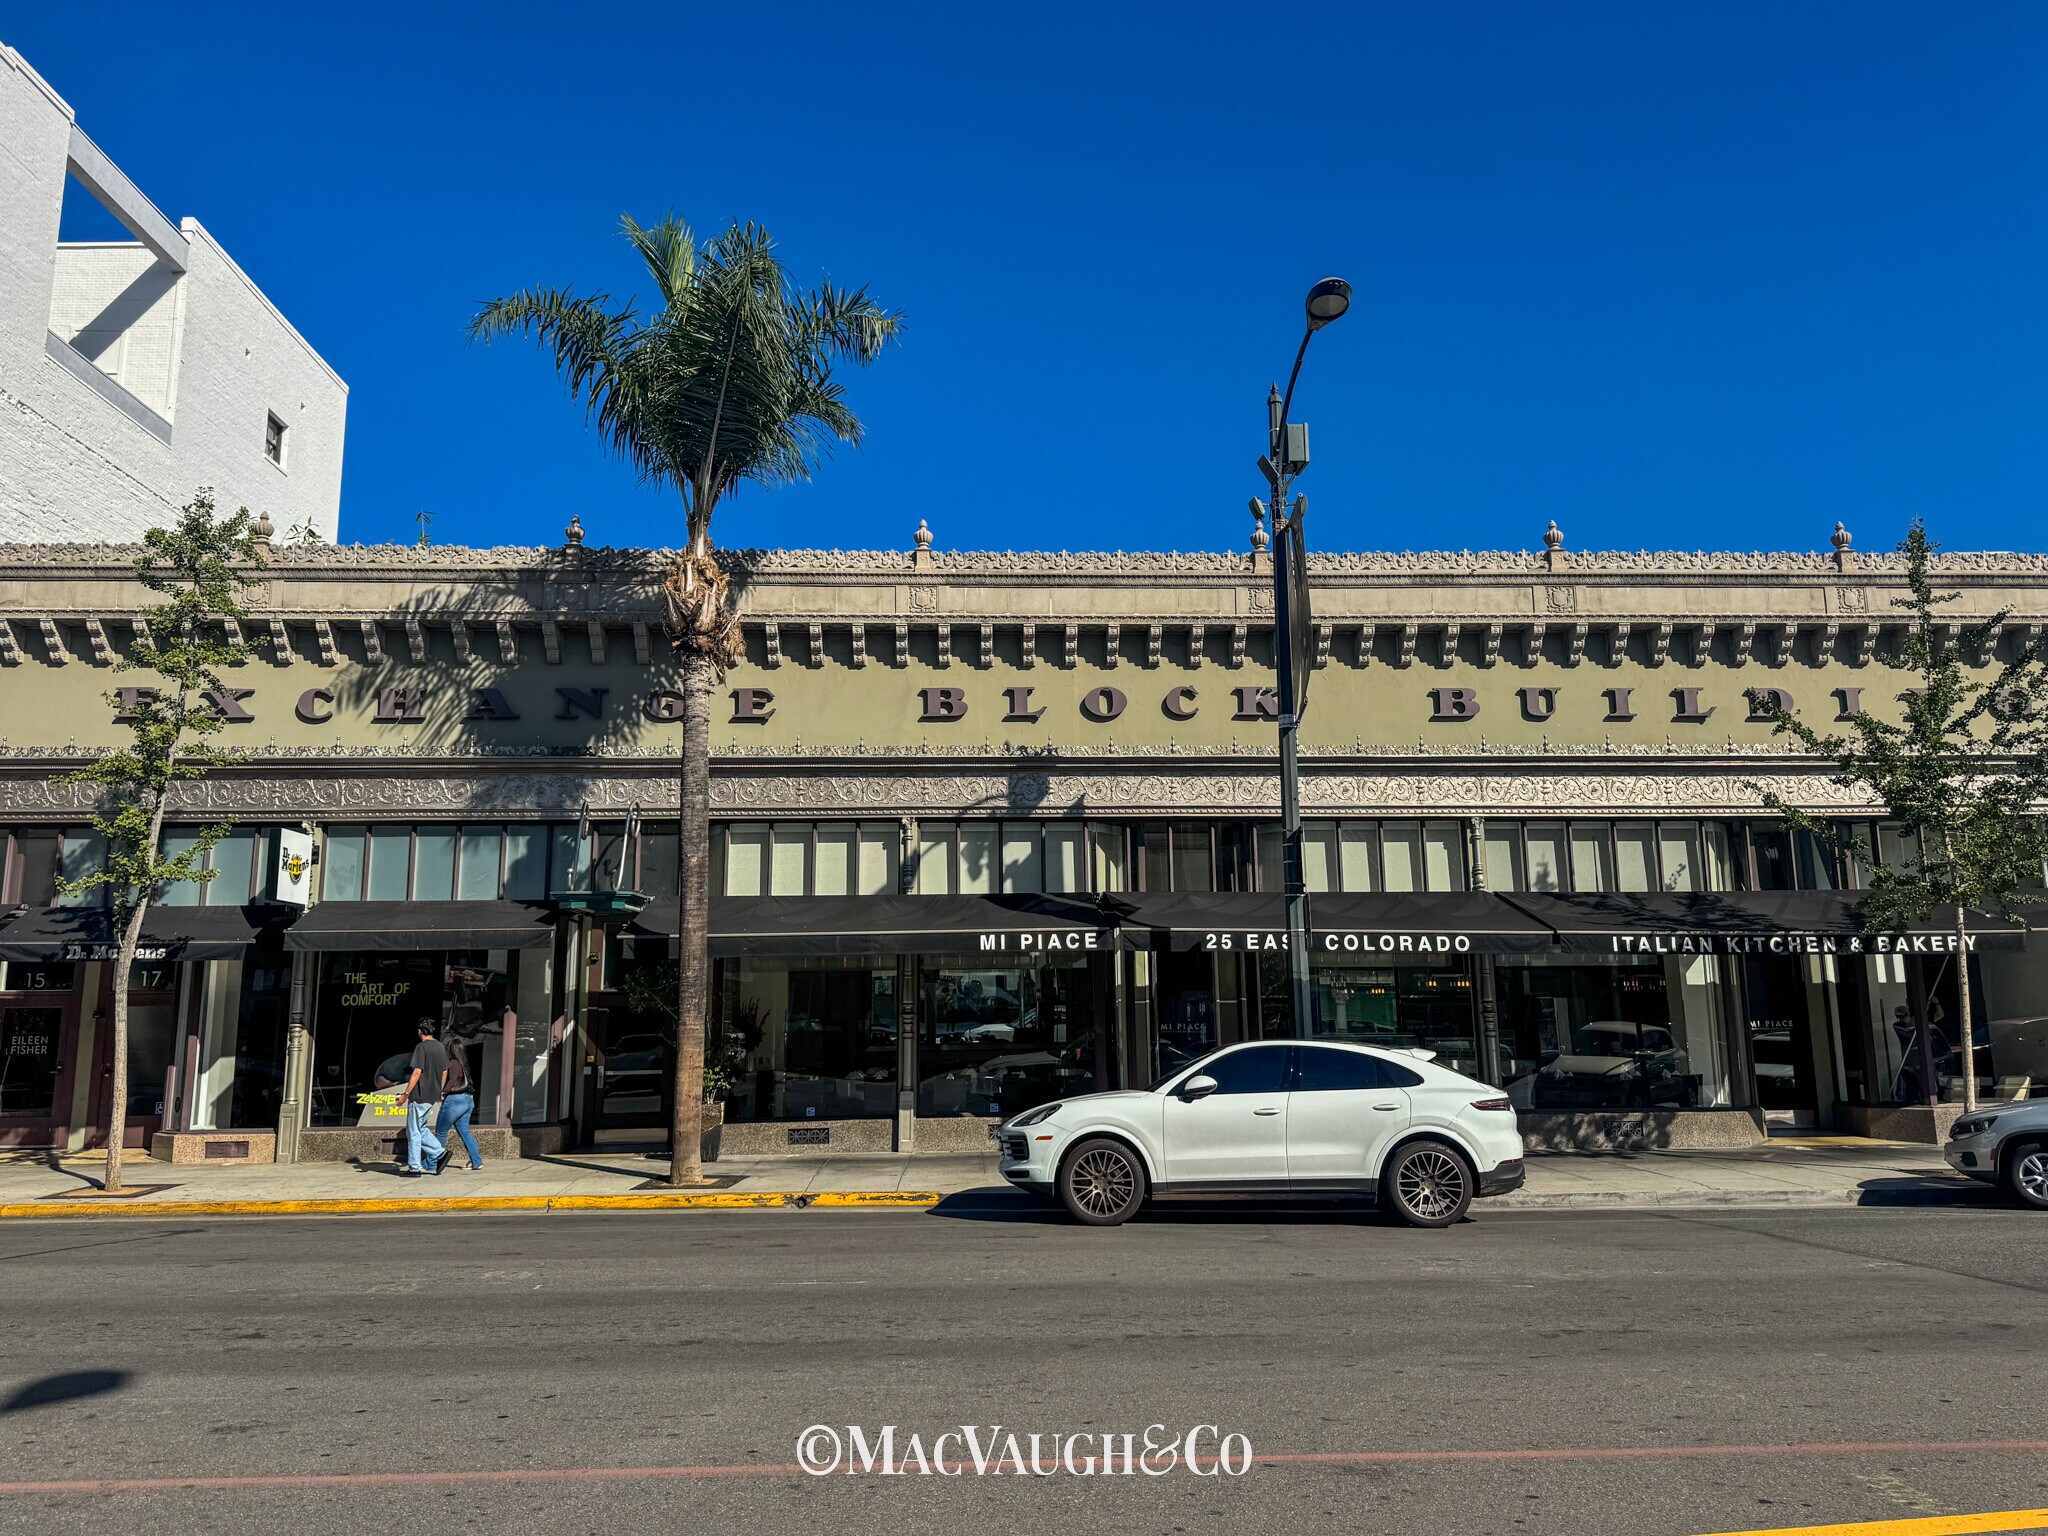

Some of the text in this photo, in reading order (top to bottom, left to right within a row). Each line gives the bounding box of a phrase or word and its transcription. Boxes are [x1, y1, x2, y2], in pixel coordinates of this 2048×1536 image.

[112, 685, 2041, 725] EXCHANGE BLOCK BUILDIG
[979, 932, 1098, 950] MI PIACE
[1205, 933, 1471, 952] 25 EA COLORADO
[1612, 935, 1977, 953] ITALIAN KITCHEN & BAKERY
[90, 945, 167, 960] Maens
[27, 972, 46, 988] 15
[141, 970, 162, 987] 17
[343, 972, 367, 984] THE
[360, 982, 411, 994] ART OF
[341, 994, 399, 1006] COMFORT
[1765, 1019, 1794, 1027] PIACE
[12, 1035, 49, 1045] EILEEN
[11, 1045, 48, 1055] FISHER
